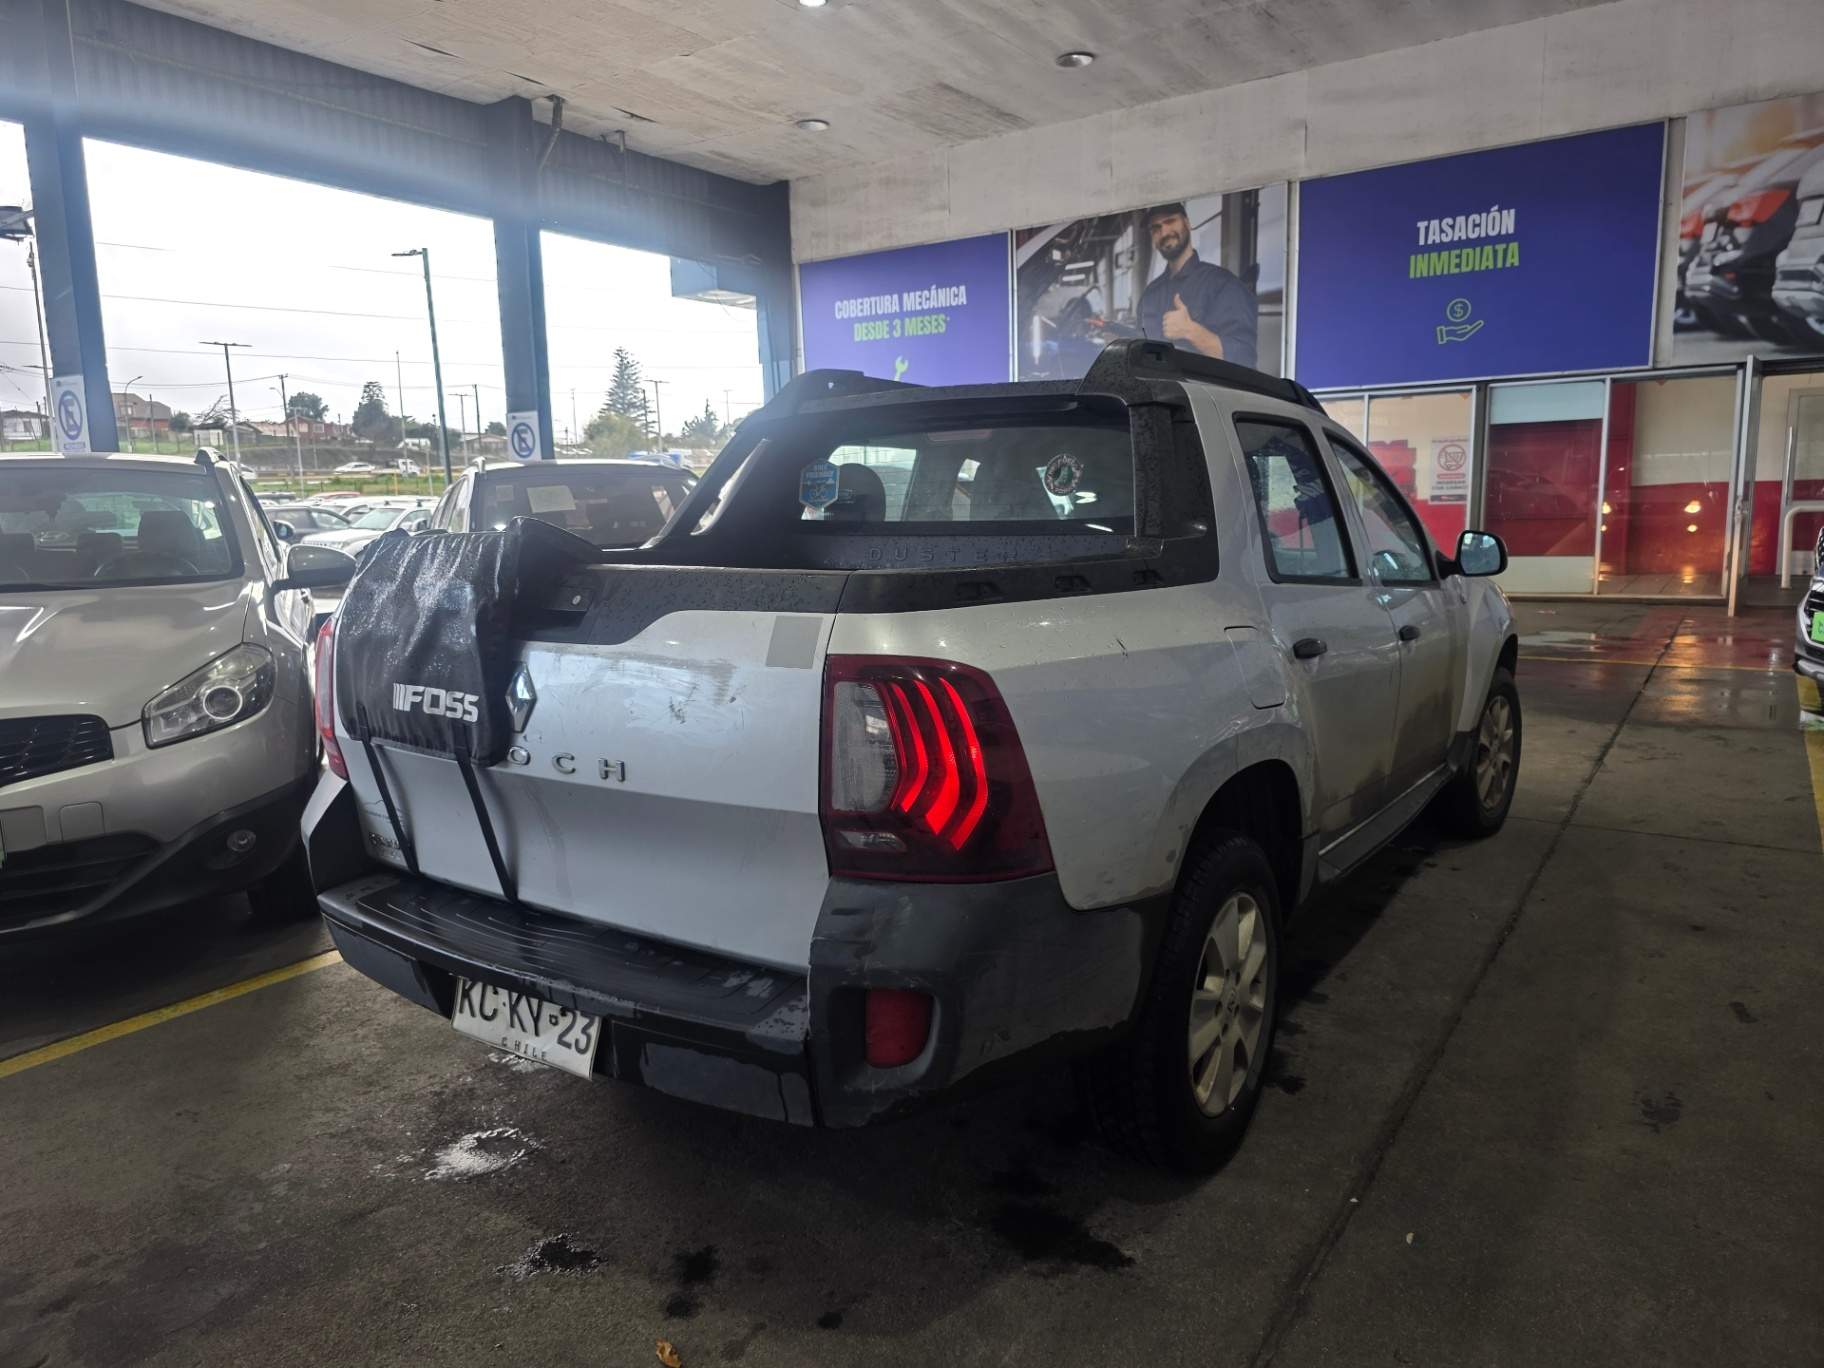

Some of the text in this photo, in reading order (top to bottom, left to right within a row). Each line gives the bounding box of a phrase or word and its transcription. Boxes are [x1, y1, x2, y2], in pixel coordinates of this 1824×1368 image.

[1416, 204, 1516, 246] TASACIÓN
[1409, 241, 1520, 279] INMEDIATA
[834, 284, 968, 320] COBERTURA MECÁNICA
[853, 319, 890, 342] DESDE
[892, 318, 902, 338] 3
[868, 543, 1018, 562] DUSTER
[393, 682, 480, 723] FOSS
[506, 745, 626, 782] OCH
[501, 1036, 548, 1062] CHILE
